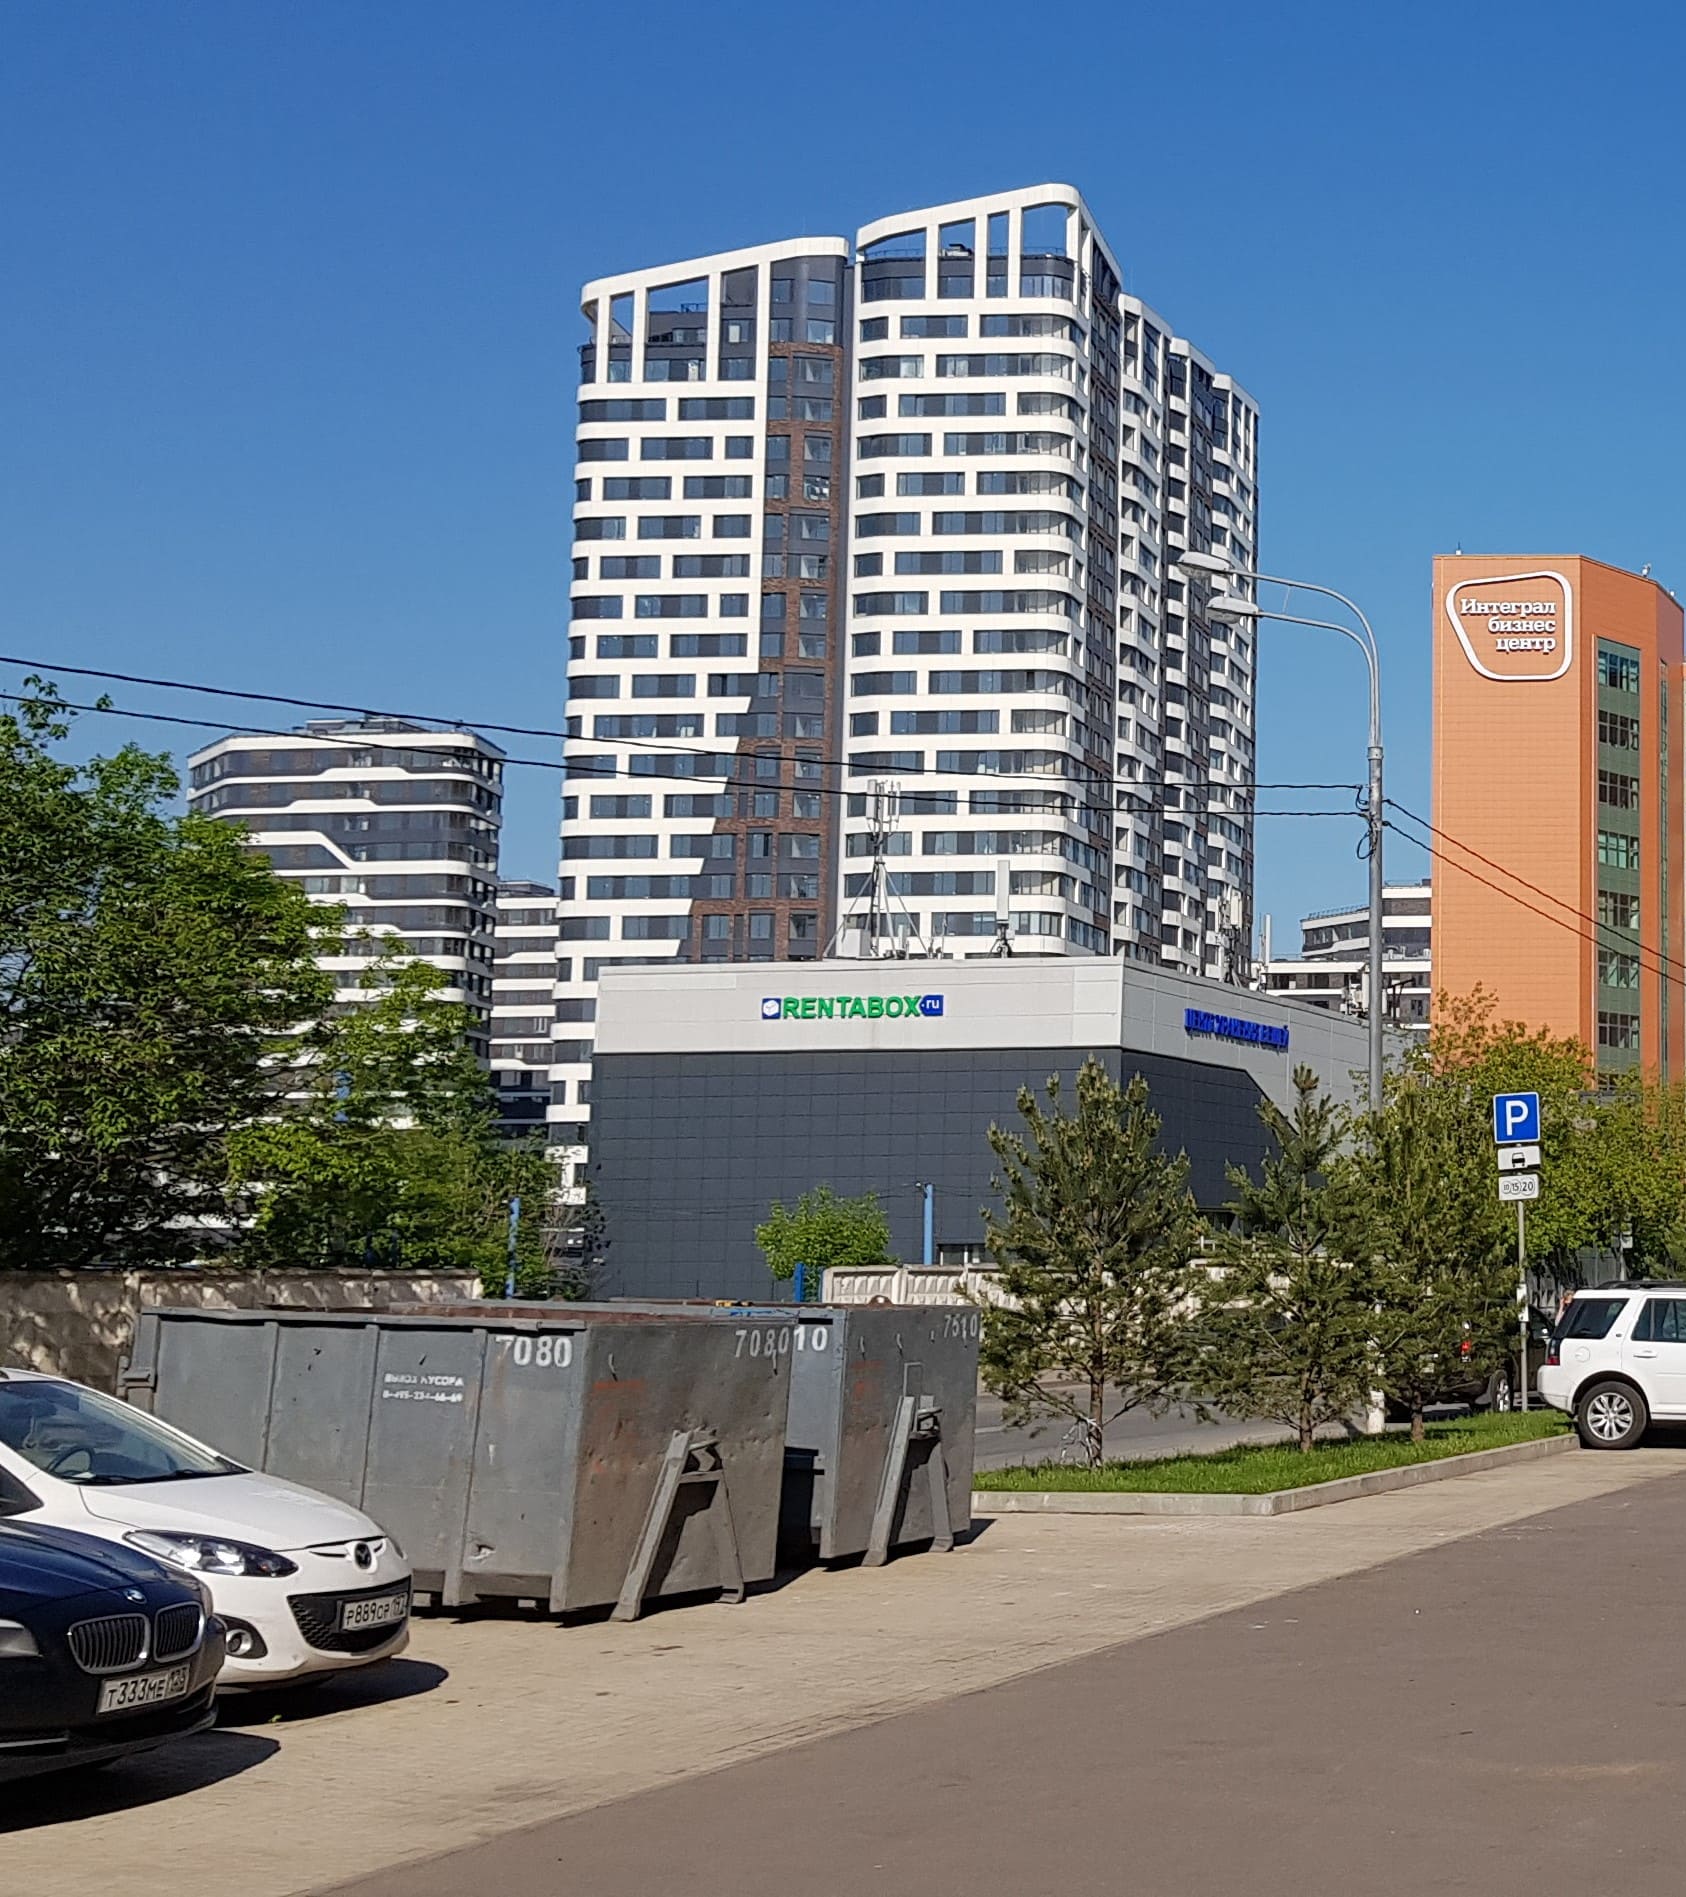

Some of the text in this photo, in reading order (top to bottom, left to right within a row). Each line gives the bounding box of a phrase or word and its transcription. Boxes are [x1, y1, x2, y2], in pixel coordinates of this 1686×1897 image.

[1460, 598, 1556, 617] Интеграл
[1488, 616, 1556, 633] бизнес
[1496, 637, 1556, 654] центр
[1505, 1100, 1529, 1136] P
[1522, 1181, 1534, 1192] 20
[495, 1335, 572, 1368] 7080
[735, 1327, 790, 1358] 7080
